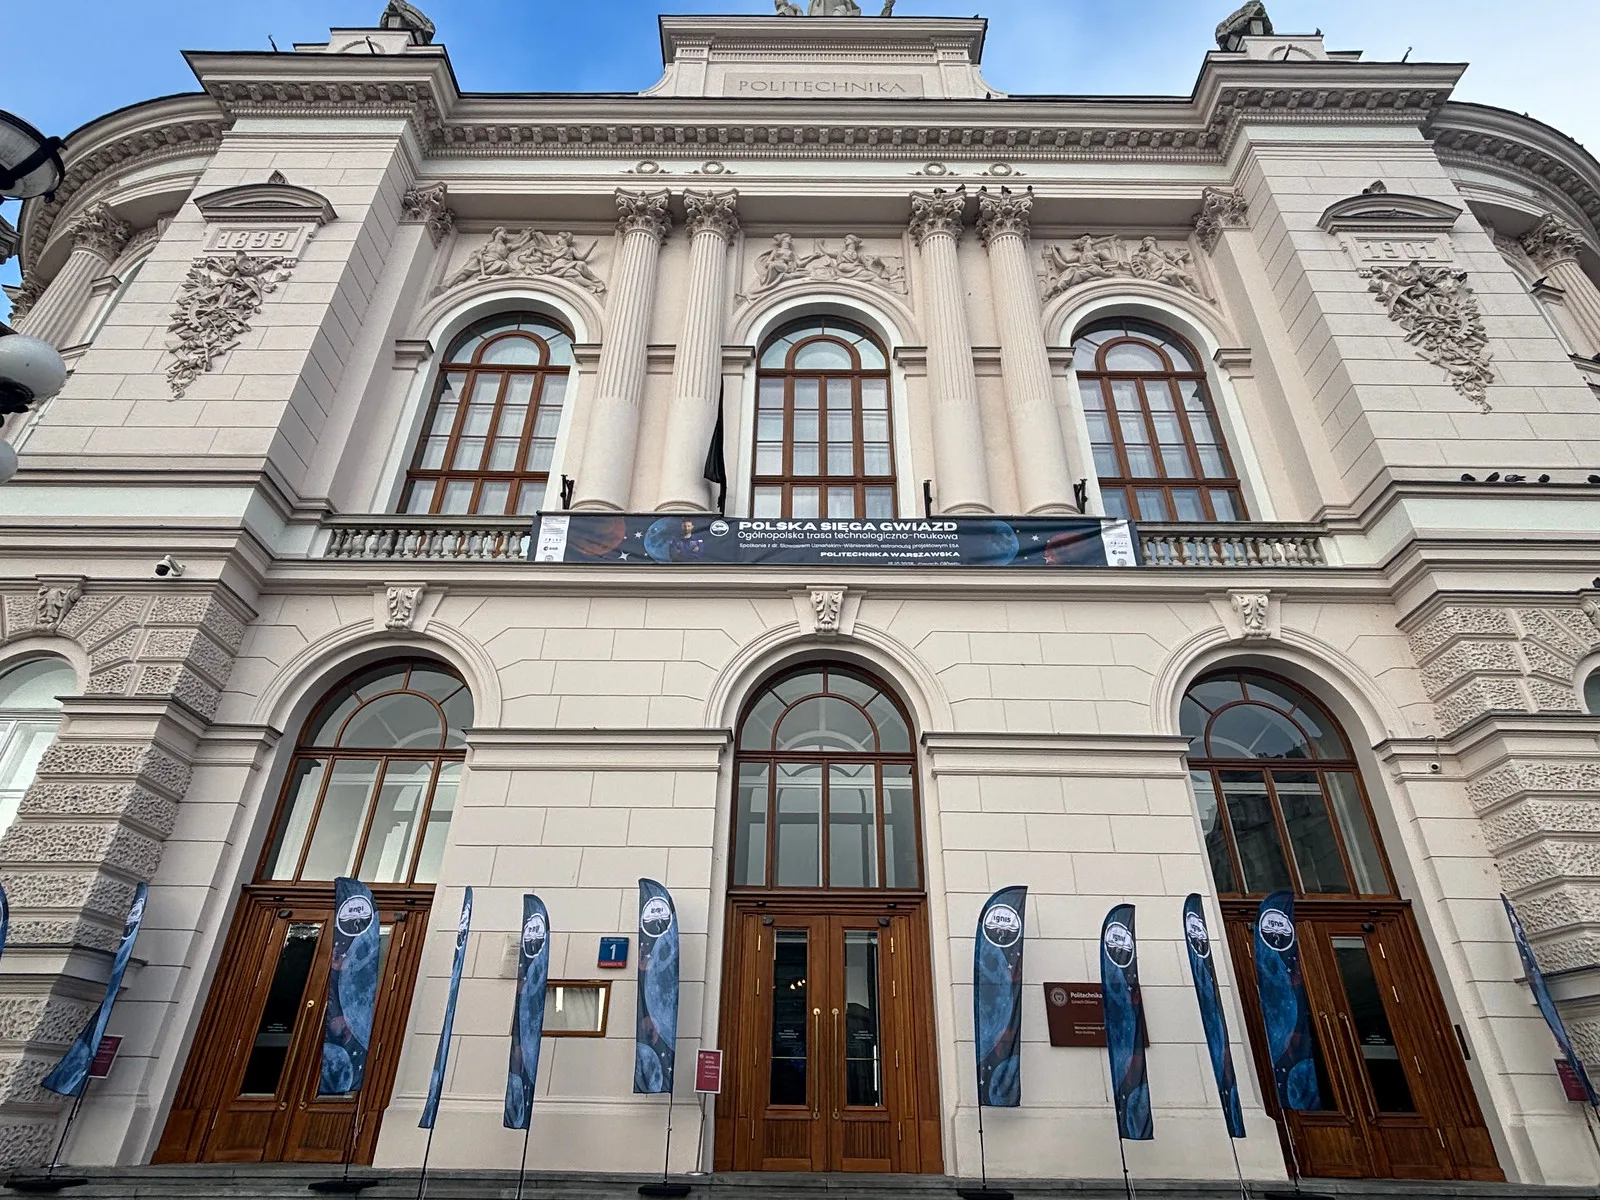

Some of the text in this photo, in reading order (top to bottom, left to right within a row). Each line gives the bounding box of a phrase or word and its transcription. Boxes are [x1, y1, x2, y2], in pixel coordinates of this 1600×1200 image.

[739, 80, 907, 92] POLITECHNIKA
[217, 230, 290, 249] 1899
[1363, 239, 1438, 259] 1901
[739, 521, 958, 533] POLSKA SIĘGA GWIAZD
[737, 530, 959, 542] Ogólnopolska trasa technologiczno-naukowa
[993, 915, 1012, 923] ignis
[609, 943, 617, 960] 1
[1070, 991, 1103, 999] Politechnika
